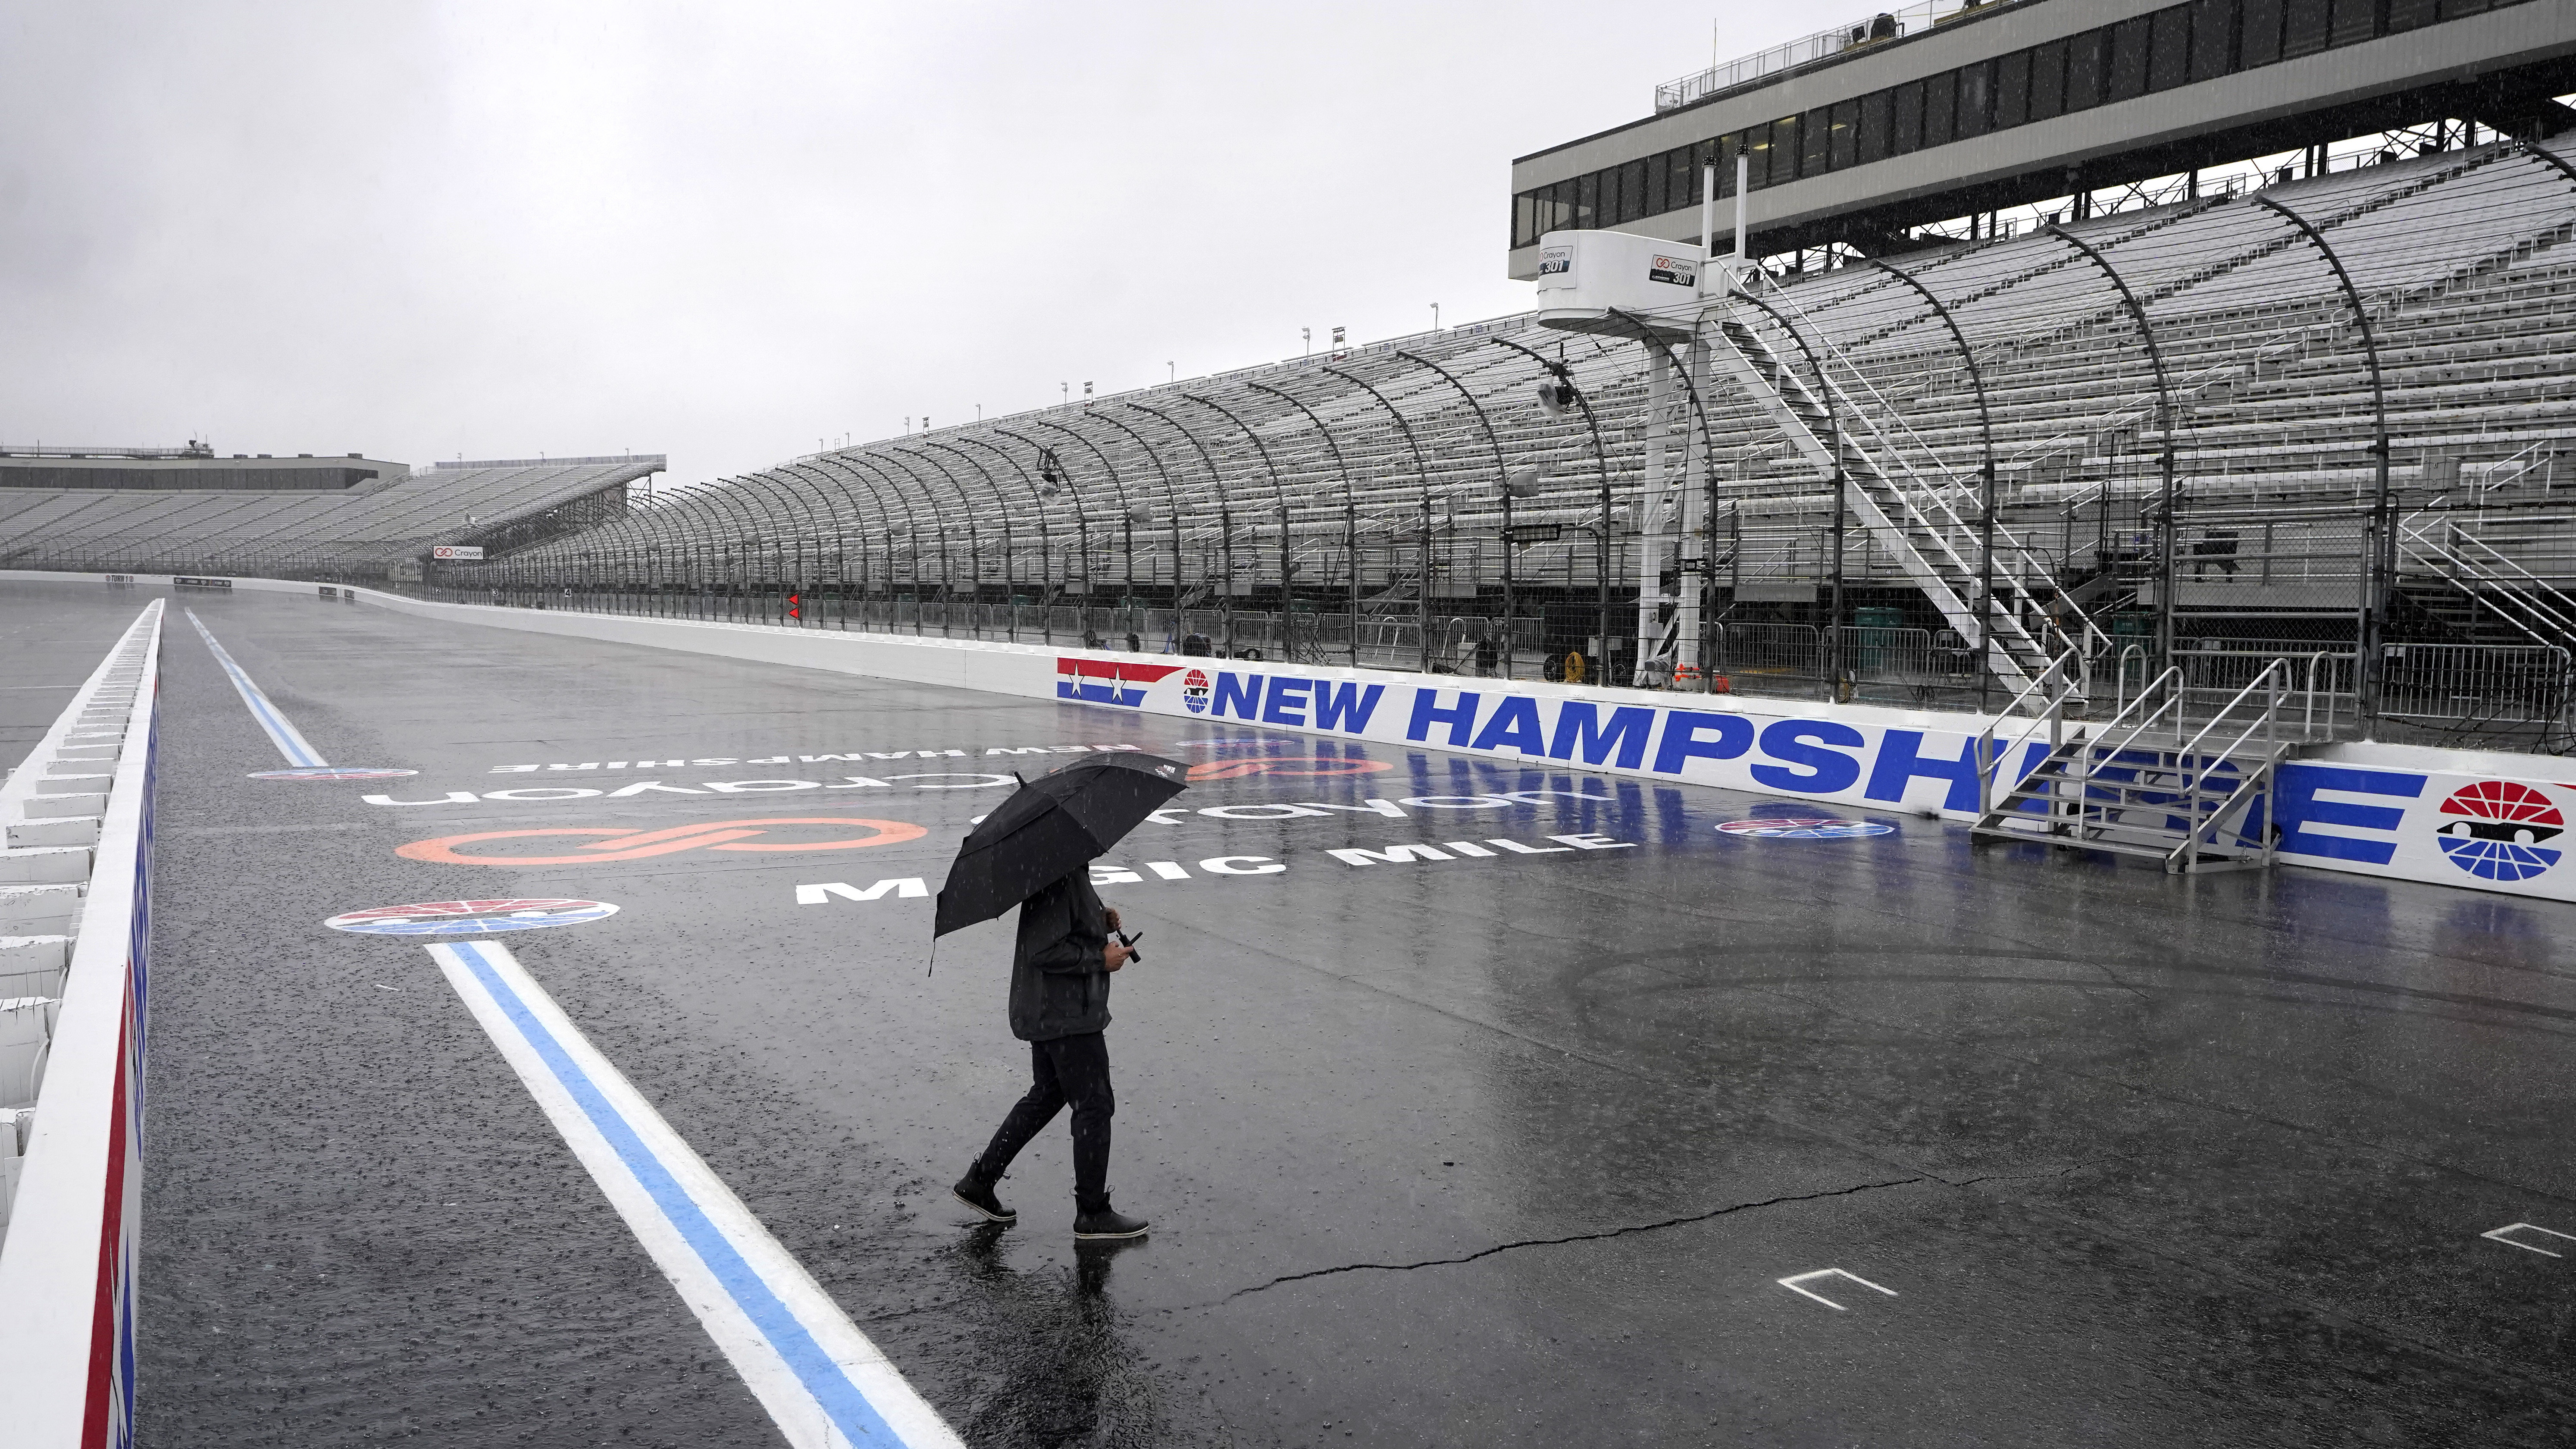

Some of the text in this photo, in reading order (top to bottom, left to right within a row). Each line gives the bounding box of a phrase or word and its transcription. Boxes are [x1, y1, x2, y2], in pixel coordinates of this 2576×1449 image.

[1545, 260, 1565, 273] 301
[1671, 261, 1692, 271] Crayon
[1673, 272, 1691, 285] 301
[455, 549, 482, 558] Crayon
[1211, 672, 1386, 734] NEW
[488, 744, 1142, 773] NEW HAMPSHIRE
[361, 772, 1024, 806] Crayon
[970, 790, 1616, 825] rayon
[795, 833, 1638, 905] MGIC MILE
